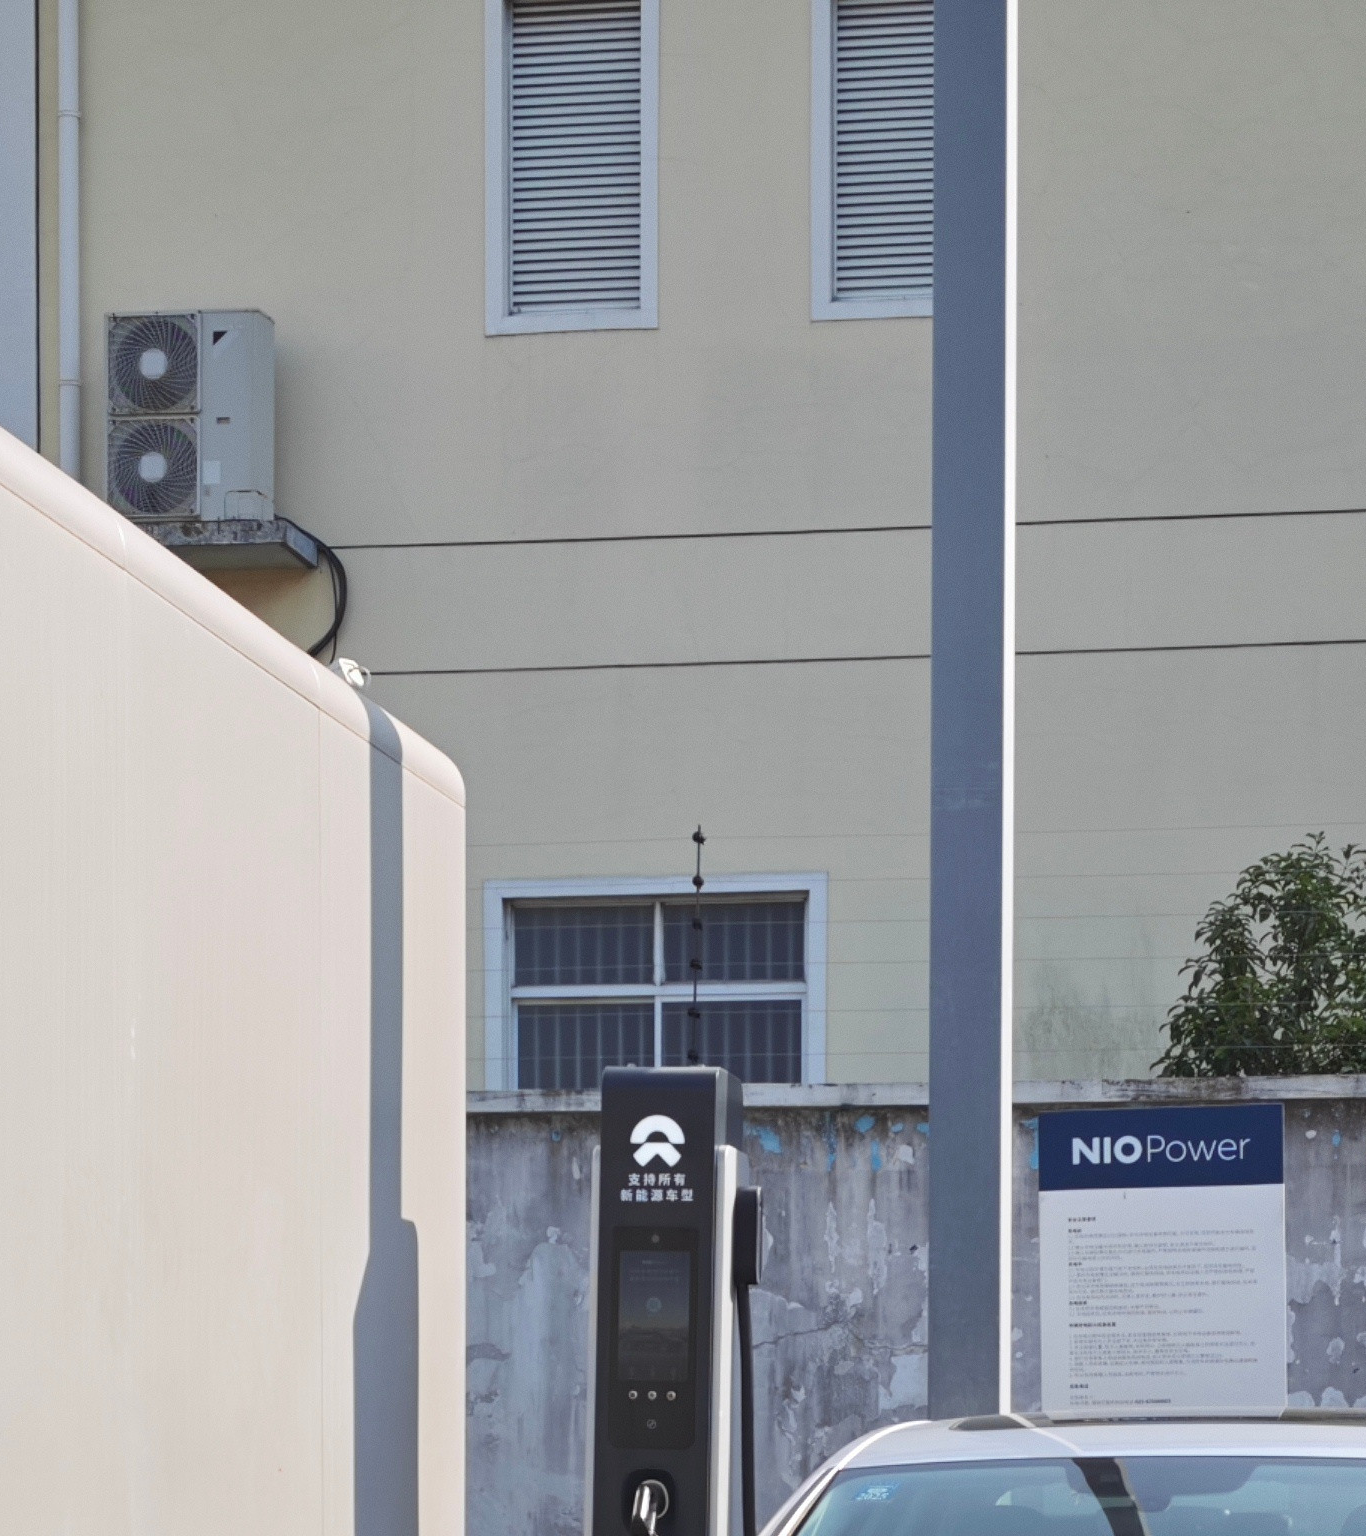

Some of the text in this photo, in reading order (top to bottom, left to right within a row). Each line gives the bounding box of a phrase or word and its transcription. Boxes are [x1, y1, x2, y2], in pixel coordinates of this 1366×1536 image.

[628, 1173, 686, 1187] 支持所有
[620, 1188, 694, 1202] 新能源车型
